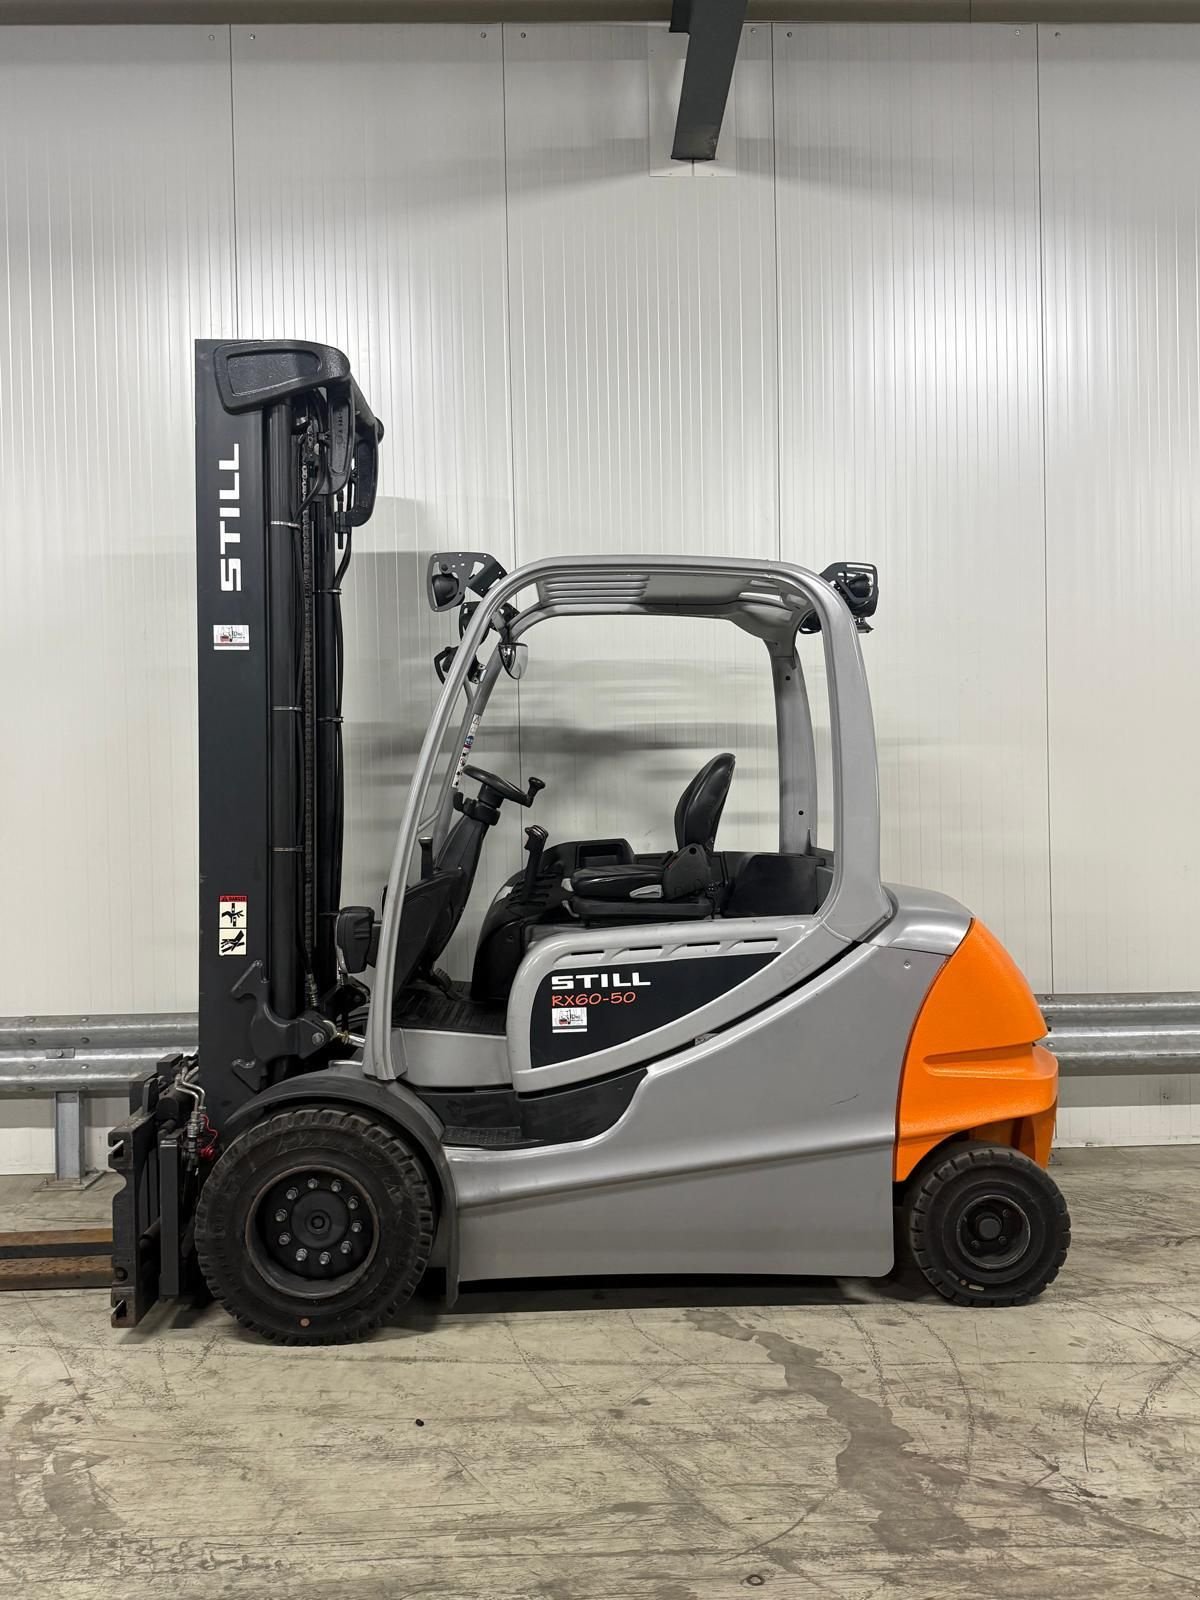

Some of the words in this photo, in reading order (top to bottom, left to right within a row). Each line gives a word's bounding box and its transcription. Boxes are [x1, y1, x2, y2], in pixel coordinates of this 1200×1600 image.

[219, 443, 241, 591] STILL
[552, 972, 651, 990] STILL
[552, 991, 636, 1007] RX60-50
